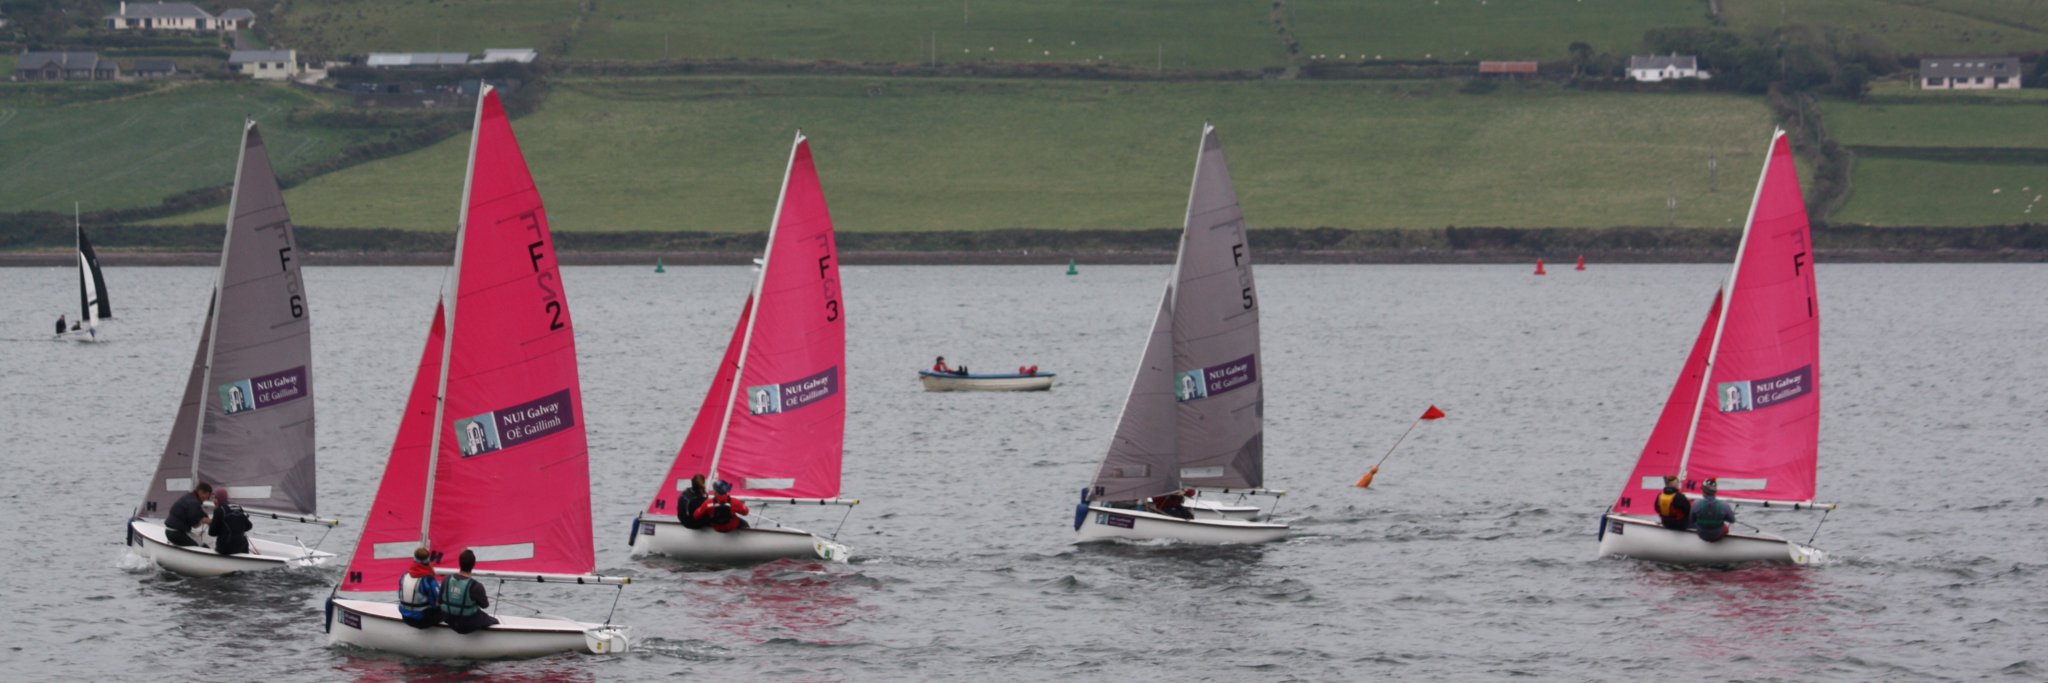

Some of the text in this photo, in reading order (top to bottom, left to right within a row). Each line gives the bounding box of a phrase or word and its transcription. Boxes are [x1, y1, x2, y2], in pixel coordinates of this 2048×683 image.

[279, 247, 291, 272] F
[528, 240, 544, 272] F
[1232, 243, 1243, 267] F
[1794, 252, 1806, 277] F
[818, 254, 831, 280] F
[290, 294, 303, 319] 6
[1242, 287, 1253, 310] 5
[546, 301, 564, 331] 2
[826, 300, 838, 322] 3
[256, 375, 298, 391] NUI Galway
[785, 376, 829, 396] NUI Galway
[1209, 369, 1225, 380] NUI
[1756, 375, 1802, 393] NUI Galway
[503, 402, 560, 426] NUI Galway
[524, 416, 562, 436] Gaillimh
[350, 571, 362, 583] H
